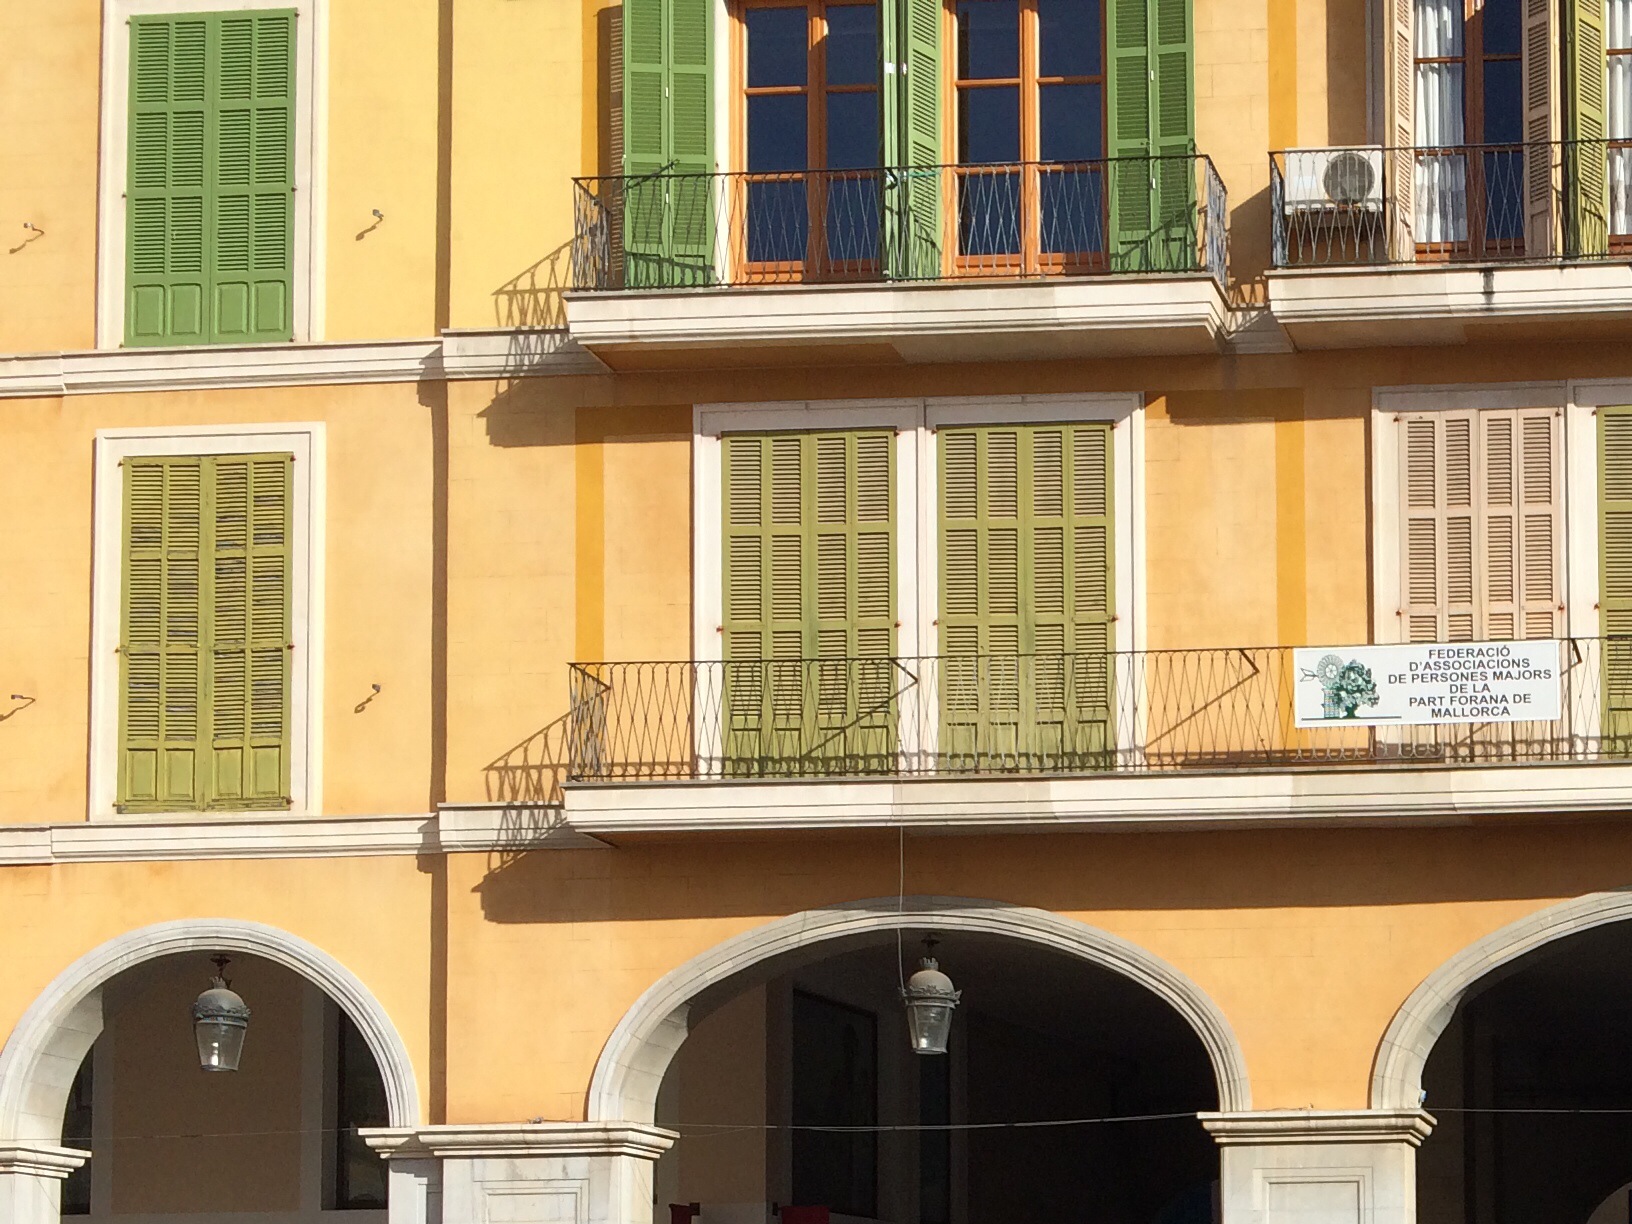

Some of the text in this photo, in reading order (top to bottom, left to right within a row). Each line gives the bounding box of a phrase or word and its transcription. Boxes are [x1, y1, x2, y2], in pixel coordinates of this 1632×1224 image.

[1428, 644, 1511, 659] FEDERACIÓ
[1409, 658, 1530, 672] D'ASSOCIACIONS
[1388, 669, 1552, 684] DE PERSONES MAJORS
[1449, 681, 1491, 694] DE LA
[1409, 693, 1532, 707] PART FORANA DE
[1431, 705, 1511, 718] MALLORCA
